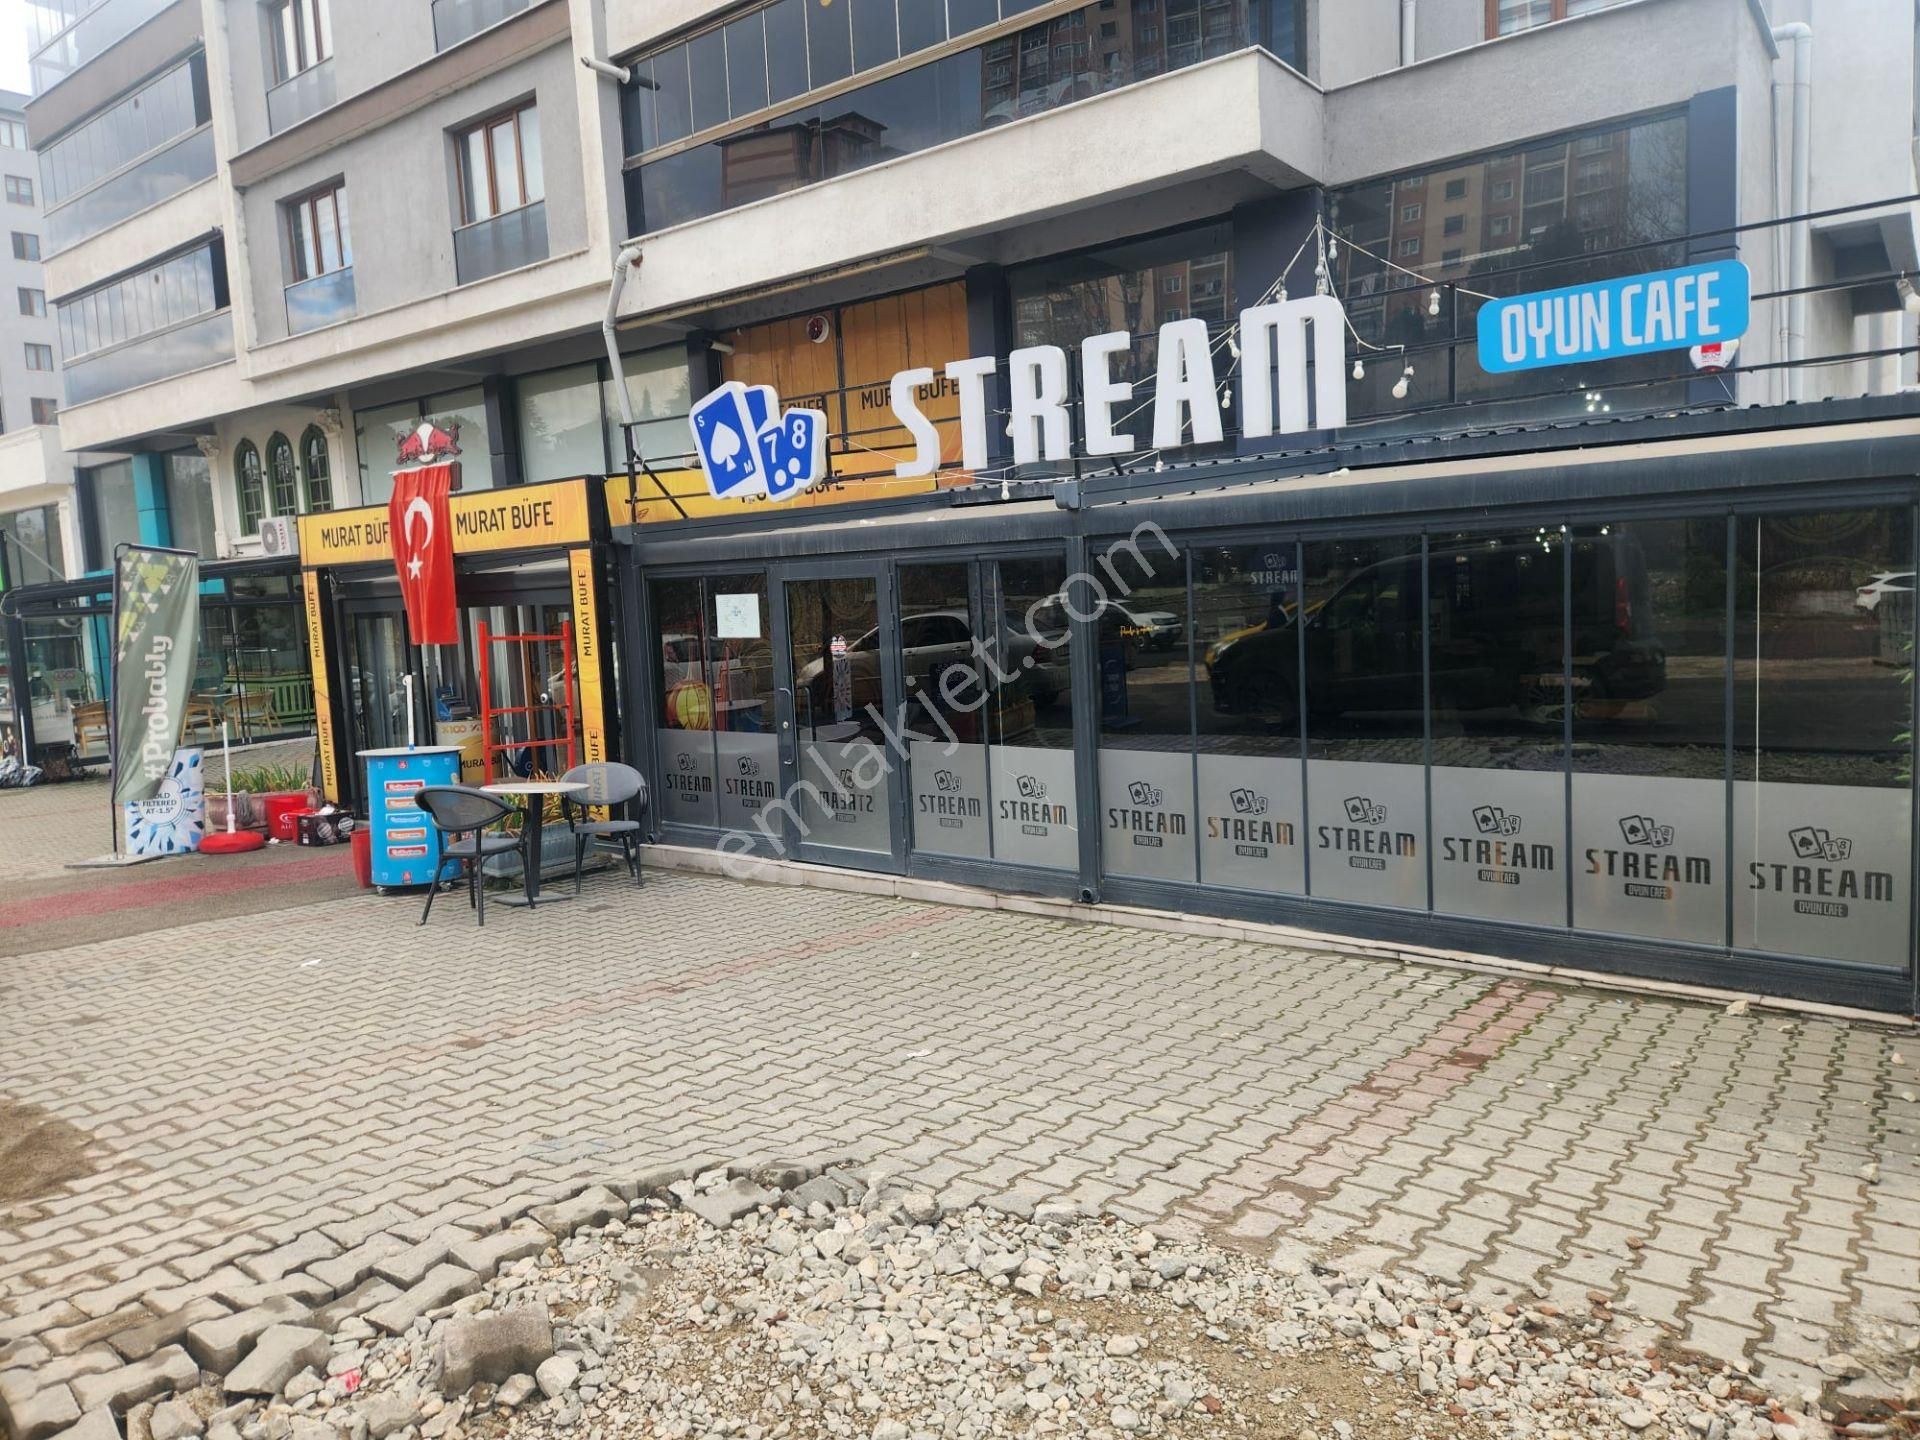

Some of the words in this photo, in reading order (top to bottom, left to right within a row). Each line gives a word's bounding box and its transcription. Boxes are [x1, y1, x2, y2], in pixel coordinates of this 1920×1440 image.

[1501, 290, 1610, 363] OYUN
[1620, 271, 1720, 346] CAFE
[862, 387, 891, 410] MUR
[891, 295, 1347, 478] STREAM
[763, 434, 777, 464] 7
[792, 419, 806, 449] 8
[456, 508, 507, 536] MURAT
[512, 498, 554, 528] BÜFE
[321, 525, 361, 548] MURAT
[365, 518, 388, 545] BÜF
[581, 610, 592, 656] MURAT
[666, 774, 712, 792] STREAM
[726, 778, 775, 798] STREAM
[919, 794, 981, 817] STREAM
[1000, 800, 1067, 825] STREAM
[1109, 808, 1186, 834] STREAM
[1207, 816, 1294, 845] STREAM
[1318, 826, 1415, 857] STREAM
[1443, 837, 1553, 870] STREAM
[1586, 849, 1710, 885] STREAM
[1749, 862, 1893, 901] STREAM
[1628, 884, 1649, 896] OYUN
[1799, 901, 1822, 915] OYUN
[1823, 903, 1844, 917] CAFE
